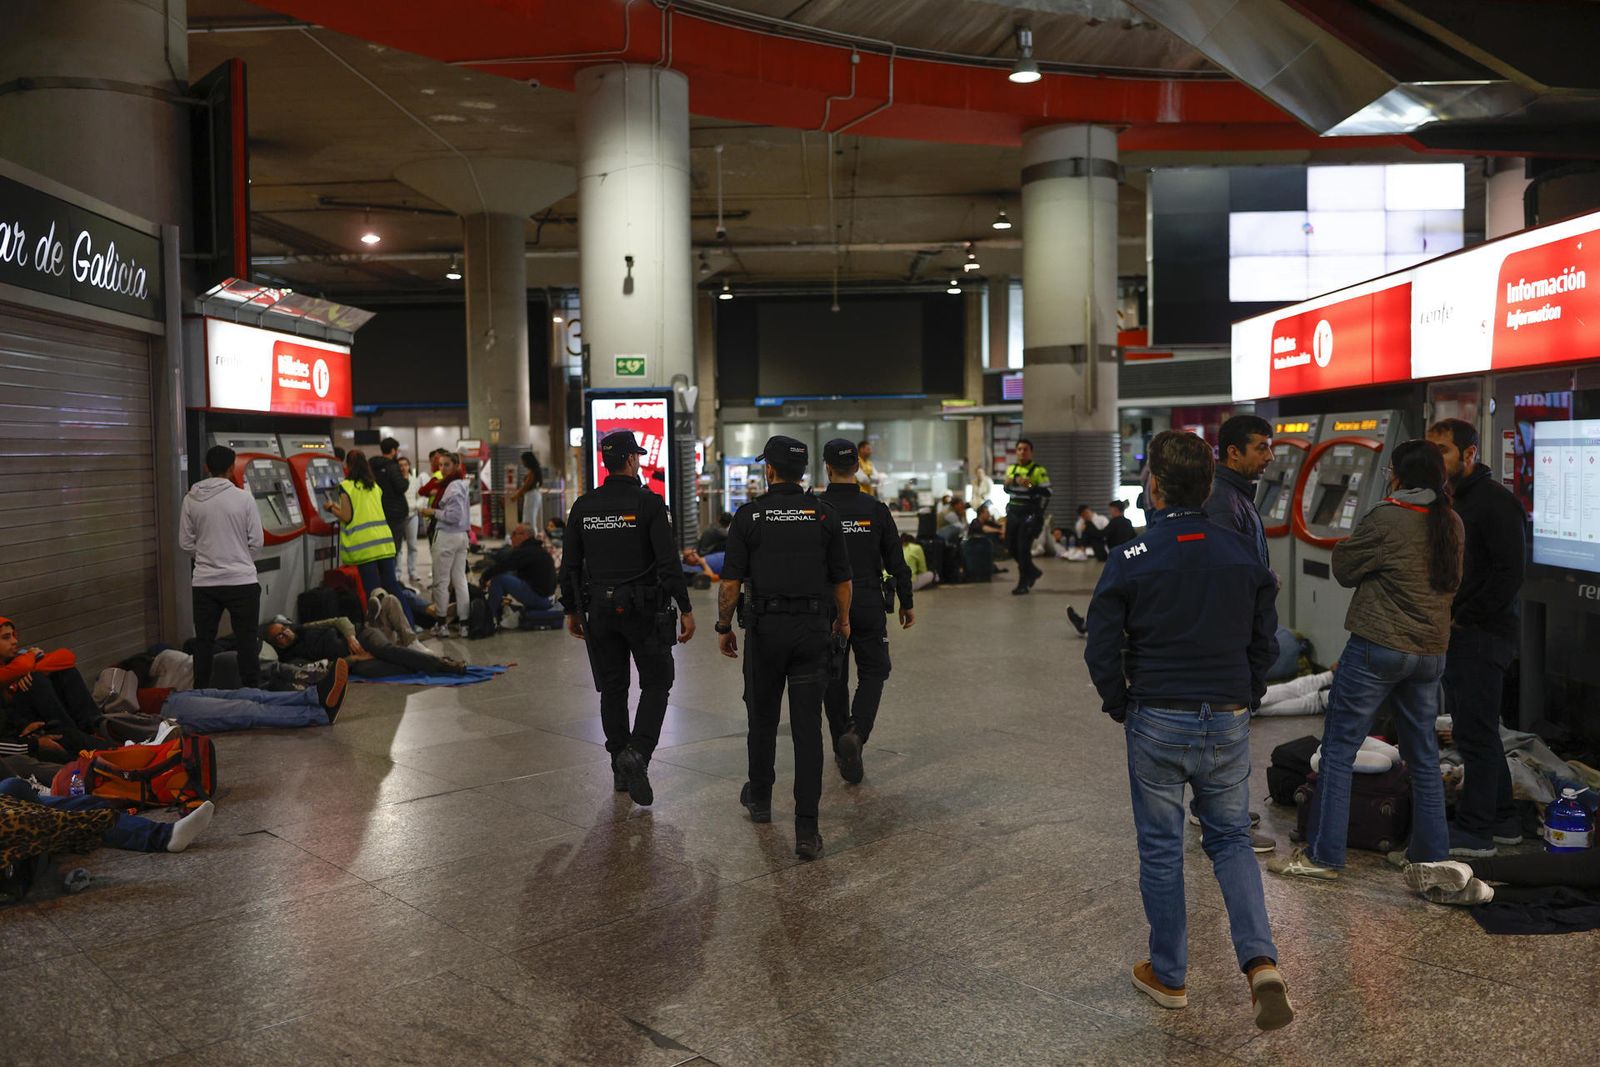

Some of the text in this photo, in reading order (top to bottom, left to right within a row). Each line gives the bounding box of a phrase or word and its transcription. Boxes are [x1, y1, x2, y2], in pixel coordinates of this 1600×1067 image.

[35, 220, 65, 277] de
[73, 230, 148, 300] Galicia
[1506, 266, 1586, 304] Información
[1506, 304, 1561, 330] Information
[583, 515, 625, 524] POLICIA
[583, 522, 637, 530] NACIONAL
[1124, 542, 1148, 560] HH
